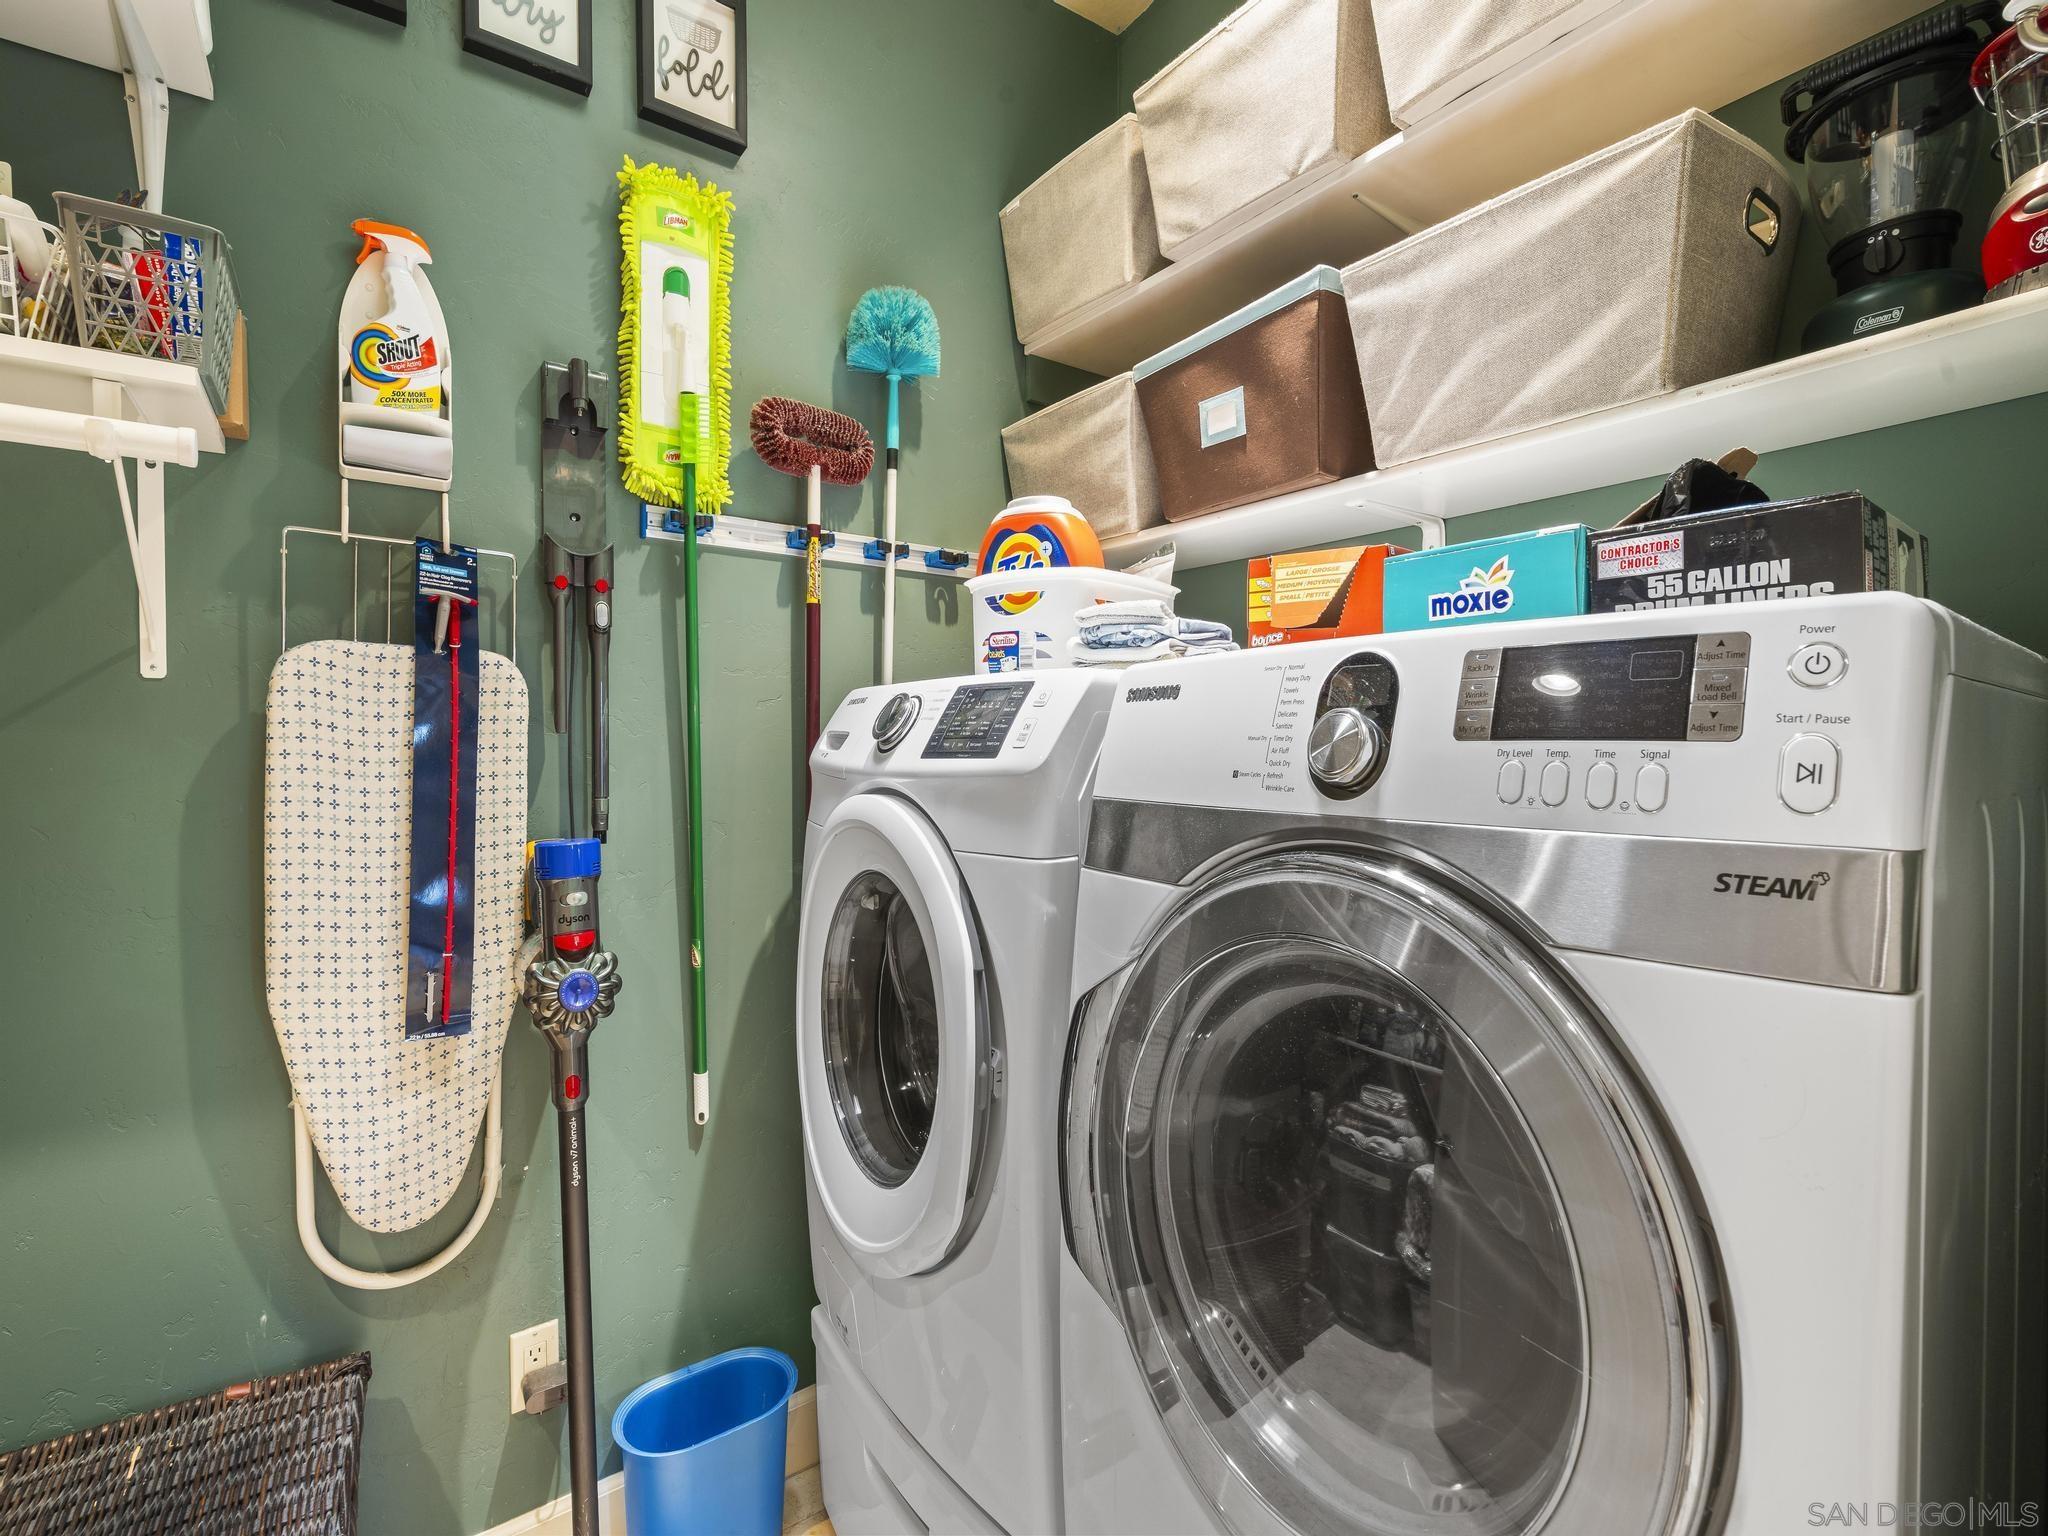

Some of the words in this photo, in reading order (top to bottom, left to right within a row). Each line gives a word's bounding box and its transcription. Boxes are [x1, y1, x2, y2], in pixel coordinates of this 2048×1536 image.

[657, 34, 730, 100] fold
[663, 215, 688, 227] LIBMAN
[1858, 313, 1892, 329] Coleman
[377, 334, 420, 364] SHOUT
[1600, 538, 1681, 560] CONTRACTOR'S
[997, 553, 1044, 571] Td
[1619, 555, 1660, 570] CHOICE
[1286, 568, 1308, 577] LARGE
[1312, 565, 1341, 574] GROSSE
[1277, 581, 1303, 589] MEDIUM
[1306, 577, 1341, 586] MOYENNE
[1647, 572, 1683, 599] 55
[1687, 558, 1791, 594] GALLON
[1278, 593, 1301, 601] SMALL
[1305, 590, 1330, 598] PETITE
[1432, 589, 1510, 617] moxie
[1799, 624, 1837, 634] Power
[991, 635, 1015, 645] Sterilite
[1251, 632, 1284, 647] bounce
[1697, 652, 1723, 661] Adjust
[1725, 651, 1746, 659] Time
[1483, 664, 1495, 673] Dry
[1300, 674, 1311, 682] Duty
[1126, 684, 1181, 703] SAMSUNG
[1704, 683, 1732, 692] Mixed
[1697, 692, 1718, 701] Load
[1720, 691, 1737, 700] Bell
[1775, 713, 1804, 724] Start
[1806, 713, 1812, 724] /
[1815, 713, 1851, 724] Pause
[1690, 724, 1716, 734] Adjust
[1718, 723, 1739, 732] Time
[1285, 735, 1293, 743] Dry
[1497, 749, 1510, 759] Dry
[1512, 749, 1533, 758] Level
[1545, 749, 1572, 760] Temp.
[1594, 749, 1617, 759] Time
[1640, 749, 1671, 761] Signal
[1282, 760, 1290, 768] Dry
[1713, 872, 1820, 901] STEAM
[558, 914, 590, 926] dyson
[569, 1116, 578, 1149] animal+
[570, 1150, 578, 1160] v7
[571, 1160, 581, 1187] dyson
